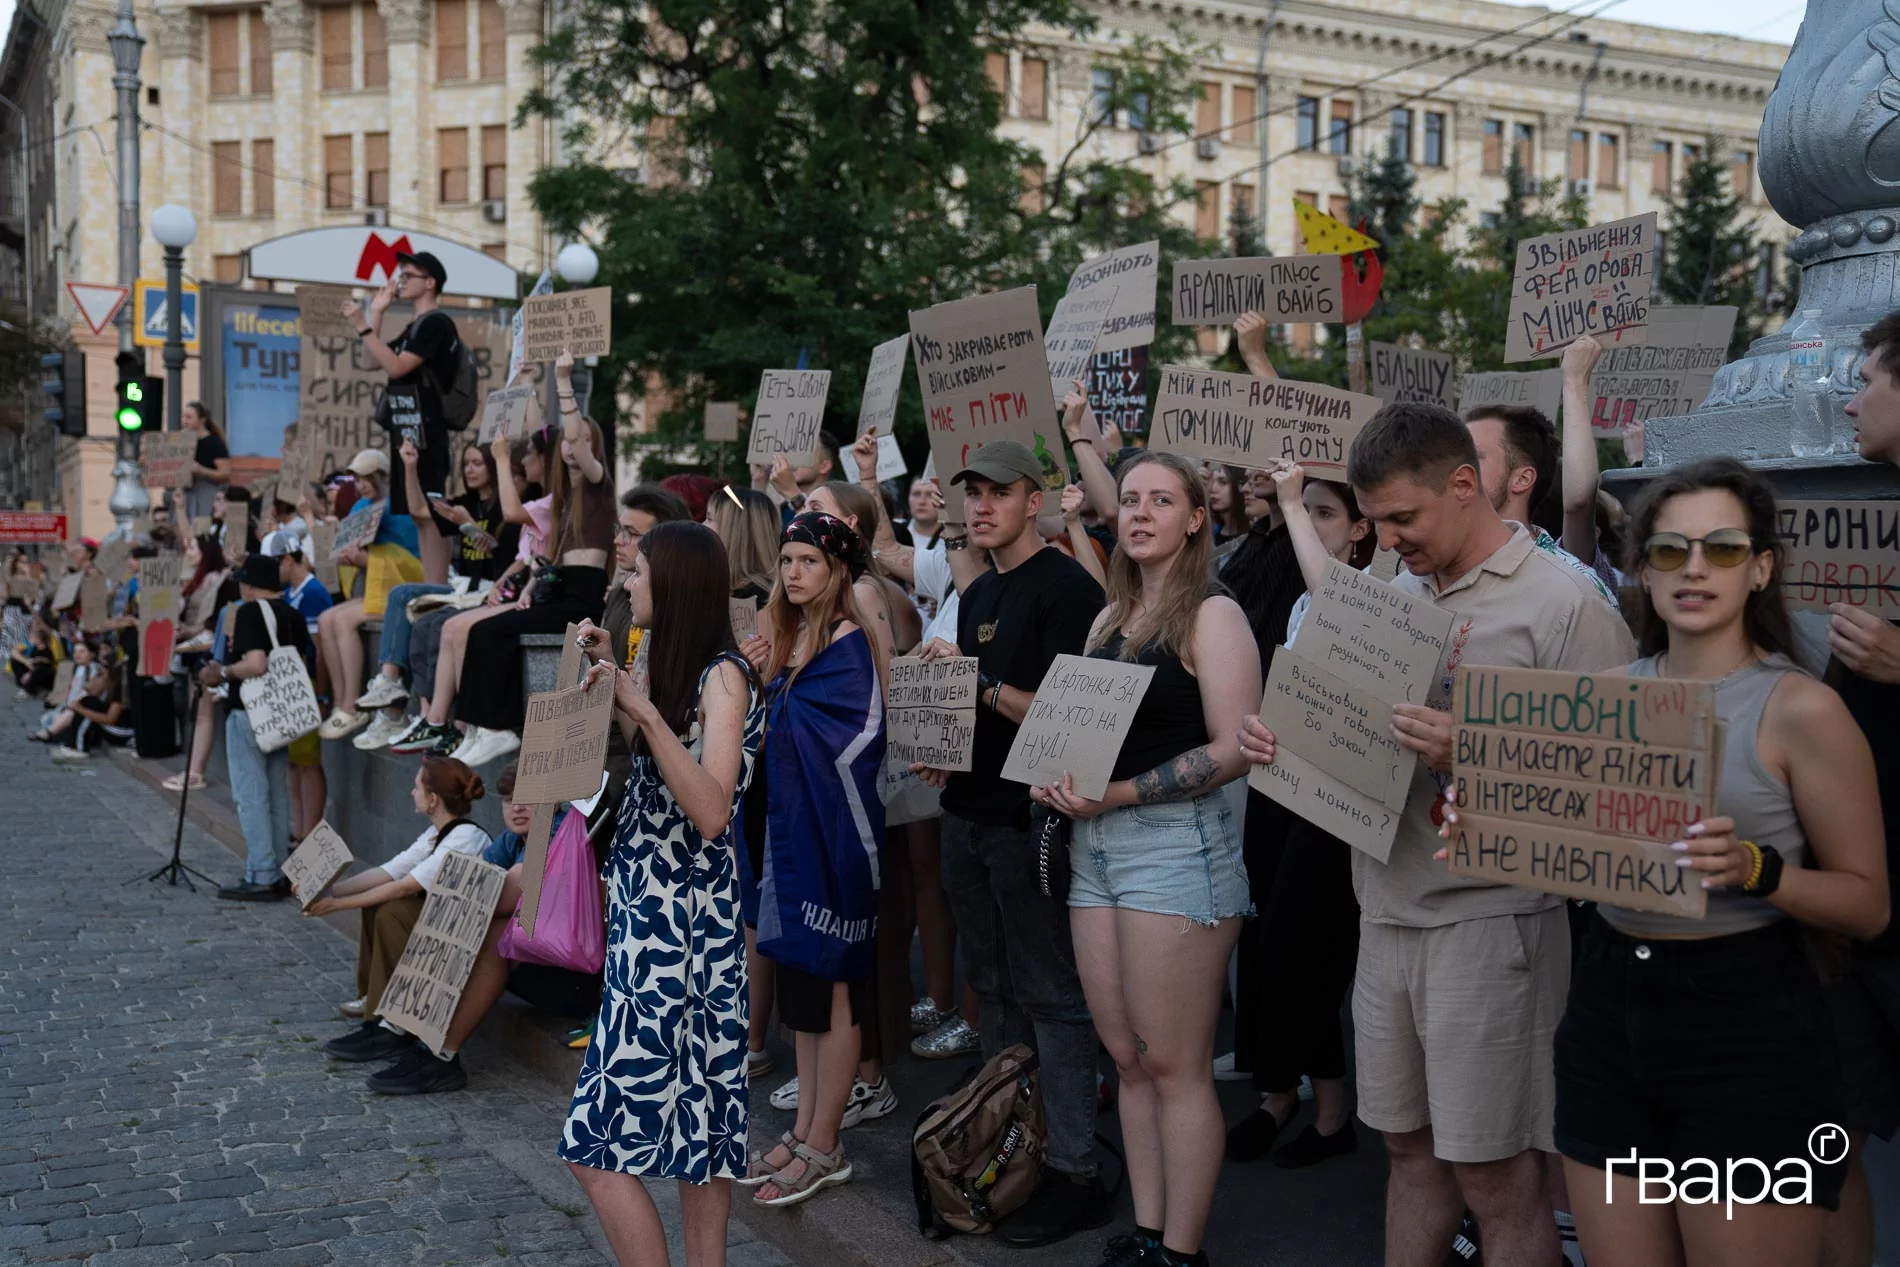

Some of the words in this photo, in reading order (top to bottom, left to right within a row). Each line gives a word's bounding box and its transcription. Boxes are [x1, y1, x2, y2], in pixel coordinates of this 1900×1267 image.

[1525, 224, 1643, 271] ЗВІЛЬНЕННЯ
[1179, 270, 1265, 319] ДРАПАТИЙ
[1271, 264, 1320, 285] ПЛЮС
[1277, 285, 1333, 315] ВАЙБ
[1522, 300, 1598, 348] МІНУС
[915, 333, 943, 365] ХТО
[948, 335, 1006, 365] ЗАКРИВАЄ
[1009, 329, 1034, 347] РОТИ
[760, 373, 795, 399] ГЕТЬ
[928, 364, 995, 394] ВІЙСЬКОВИМ
[1376, 351, 1449, 398] БІЛЬШУ
[930, 405, 955, 432] МАЄ
[968, 392, 1028, 428] ПІТИ
[1168, 372, 1194, 395] МІЙ
[1201, 377, 1232, 399] ДІМ
[1249, 381, 1351, 420] ДОНЕЧЧИНА
[753, 414, 782, 453] ГЕТЬ
[1163, 408, 1254, 453] ПОМИЛКИ
[1265, 417, 1331, 435] КОШТУЮТЬ
[1281, 435, 1343, 463] ДОМУ
[1778, 507, 1900, 550] ДРОНИ
[1331, 566, 1413, 616] Цивільним
[1323, 586, 1335, 600] не
[1340, 593, 1382, 617] можна
[1391, 616, 1443, 651] говорити
[890, 662, 930, 684] ПЕРЕМОГА
[933, 661, 976, 682] ПОТРЕБУЄ
[1351, 633, 1390, 662] нічого
[1394, 658, 1411, 675] НЕ
[934, 684, 969, 703] РІШЕНЬ
[1114, 675, 1139, 703] ЗА
[1292, 665, 1368, 718] Військовим
[1030, 700, 1058, 720] ТИХ
[1063, 705, 1094, 726] ХТО
[1096, 712, 1117, 732] НА
[1277, 681, 1291, 696] не
[1296, 689, 1333, 716] можна
[1344, 715, 1401, 757] говорити
[1304, 711, 1322, 731] бо
[941, 726, 972, 749] ДОМУ
[1020, 732, 1070, 769] НУЛІ
[1315, 787, 1372, 827] можна
[1596, 789, 1702, 840] НАРОДУ
[1455, 830, 1470, 867] А
[1531, 841, 1686, 896] НАВПАКИ
